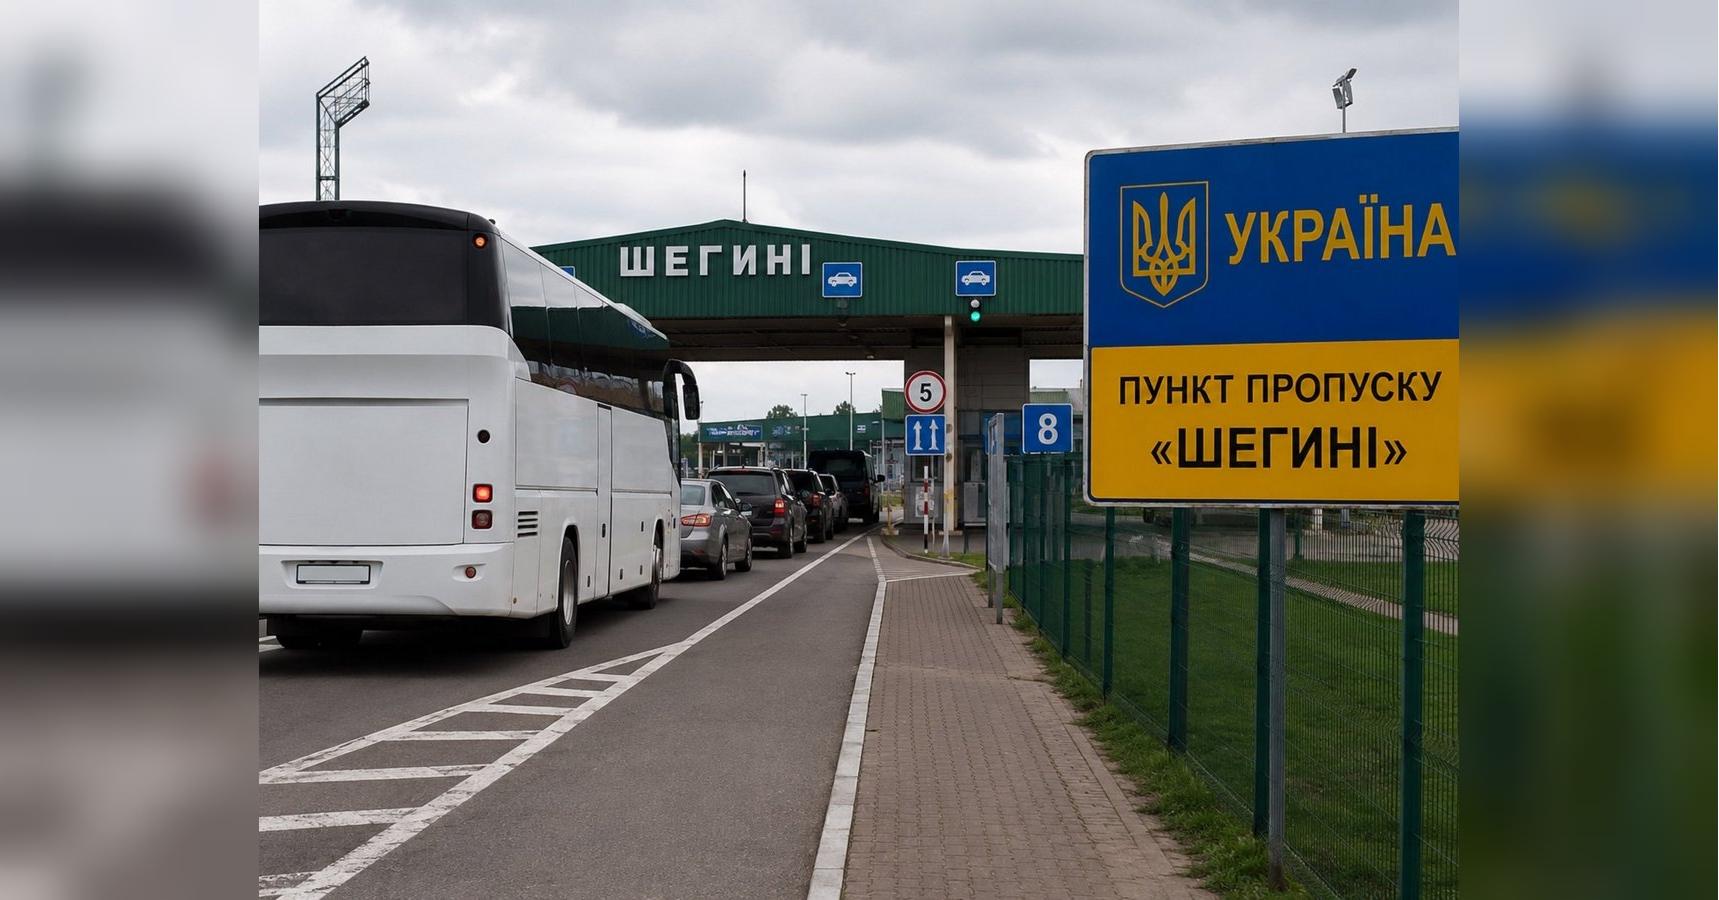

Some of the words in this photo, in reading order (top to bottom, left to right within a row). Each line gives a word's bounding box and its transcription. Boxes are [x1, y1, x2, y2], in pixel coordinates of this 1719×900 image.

[1224, 193, 1457, 265] УКРАЇНА
[619, 243, 811, 277] ШЕГИНІ
[919, 382, 933, 402] 5
[1119, 374, 1234, 405] ПУНКТ
[1246, 371, 1442, 403] ПРОПУСКУ
[1038, 412, 1059, 445] 8
[1150, 426, 1407, 469] «ШЕГИНІ»
